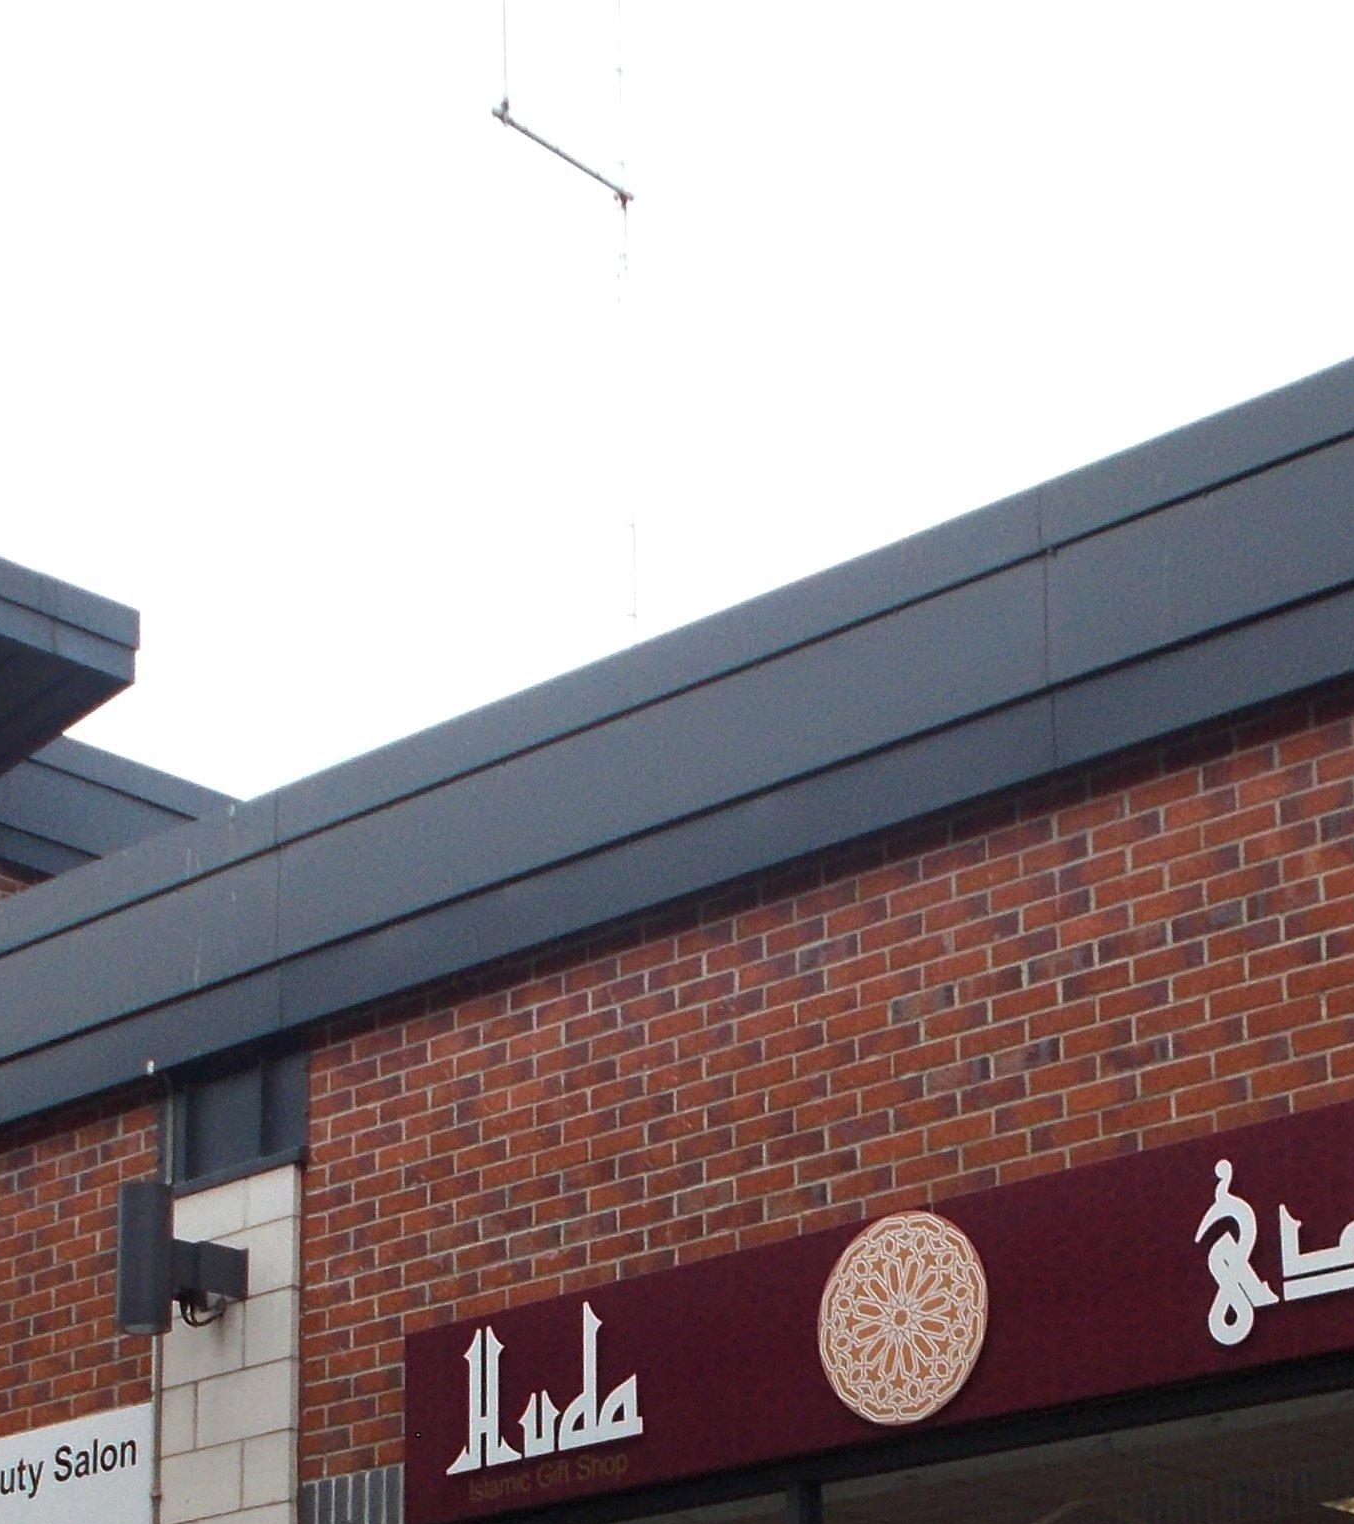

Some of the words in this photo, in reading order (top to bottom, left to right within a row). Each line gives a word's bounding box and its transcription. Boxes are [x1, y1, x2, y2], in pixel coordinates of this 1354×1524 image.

[445, 1300, 644, 1476] Huda
[54, 1438, 137, 1482] Salon
[469, 1472, 532, 1502] Islamic
[536, 1459, 570, 1489] Gift
[576, 1452, 628, 1481] Shop
